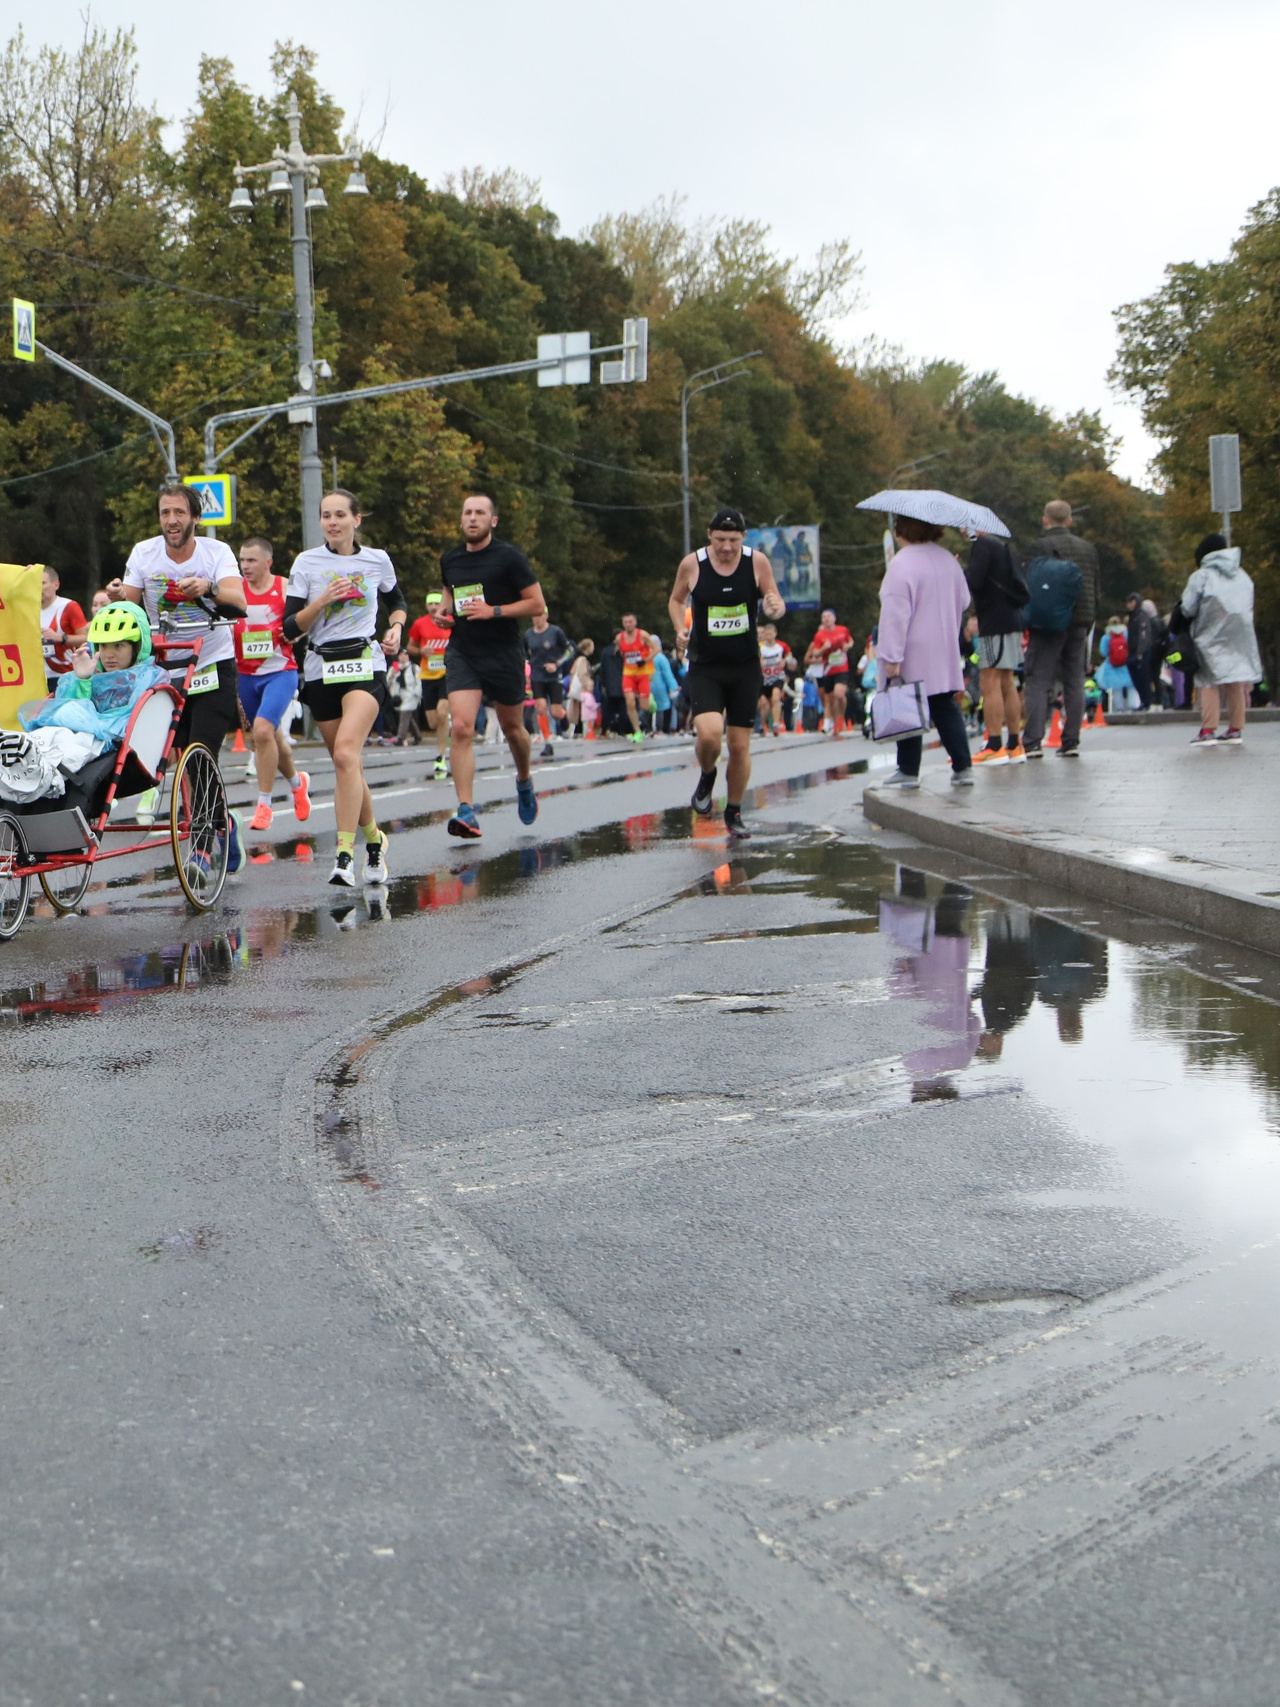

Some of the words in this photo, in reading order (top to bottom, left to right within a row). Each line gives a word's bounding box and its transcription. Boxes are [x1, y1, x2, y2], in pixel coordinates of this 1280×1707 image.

[712, 619, 742, 630] 4776
[246, 643, 270, 653] 4777
[326, 662, 363, 675] 4453
